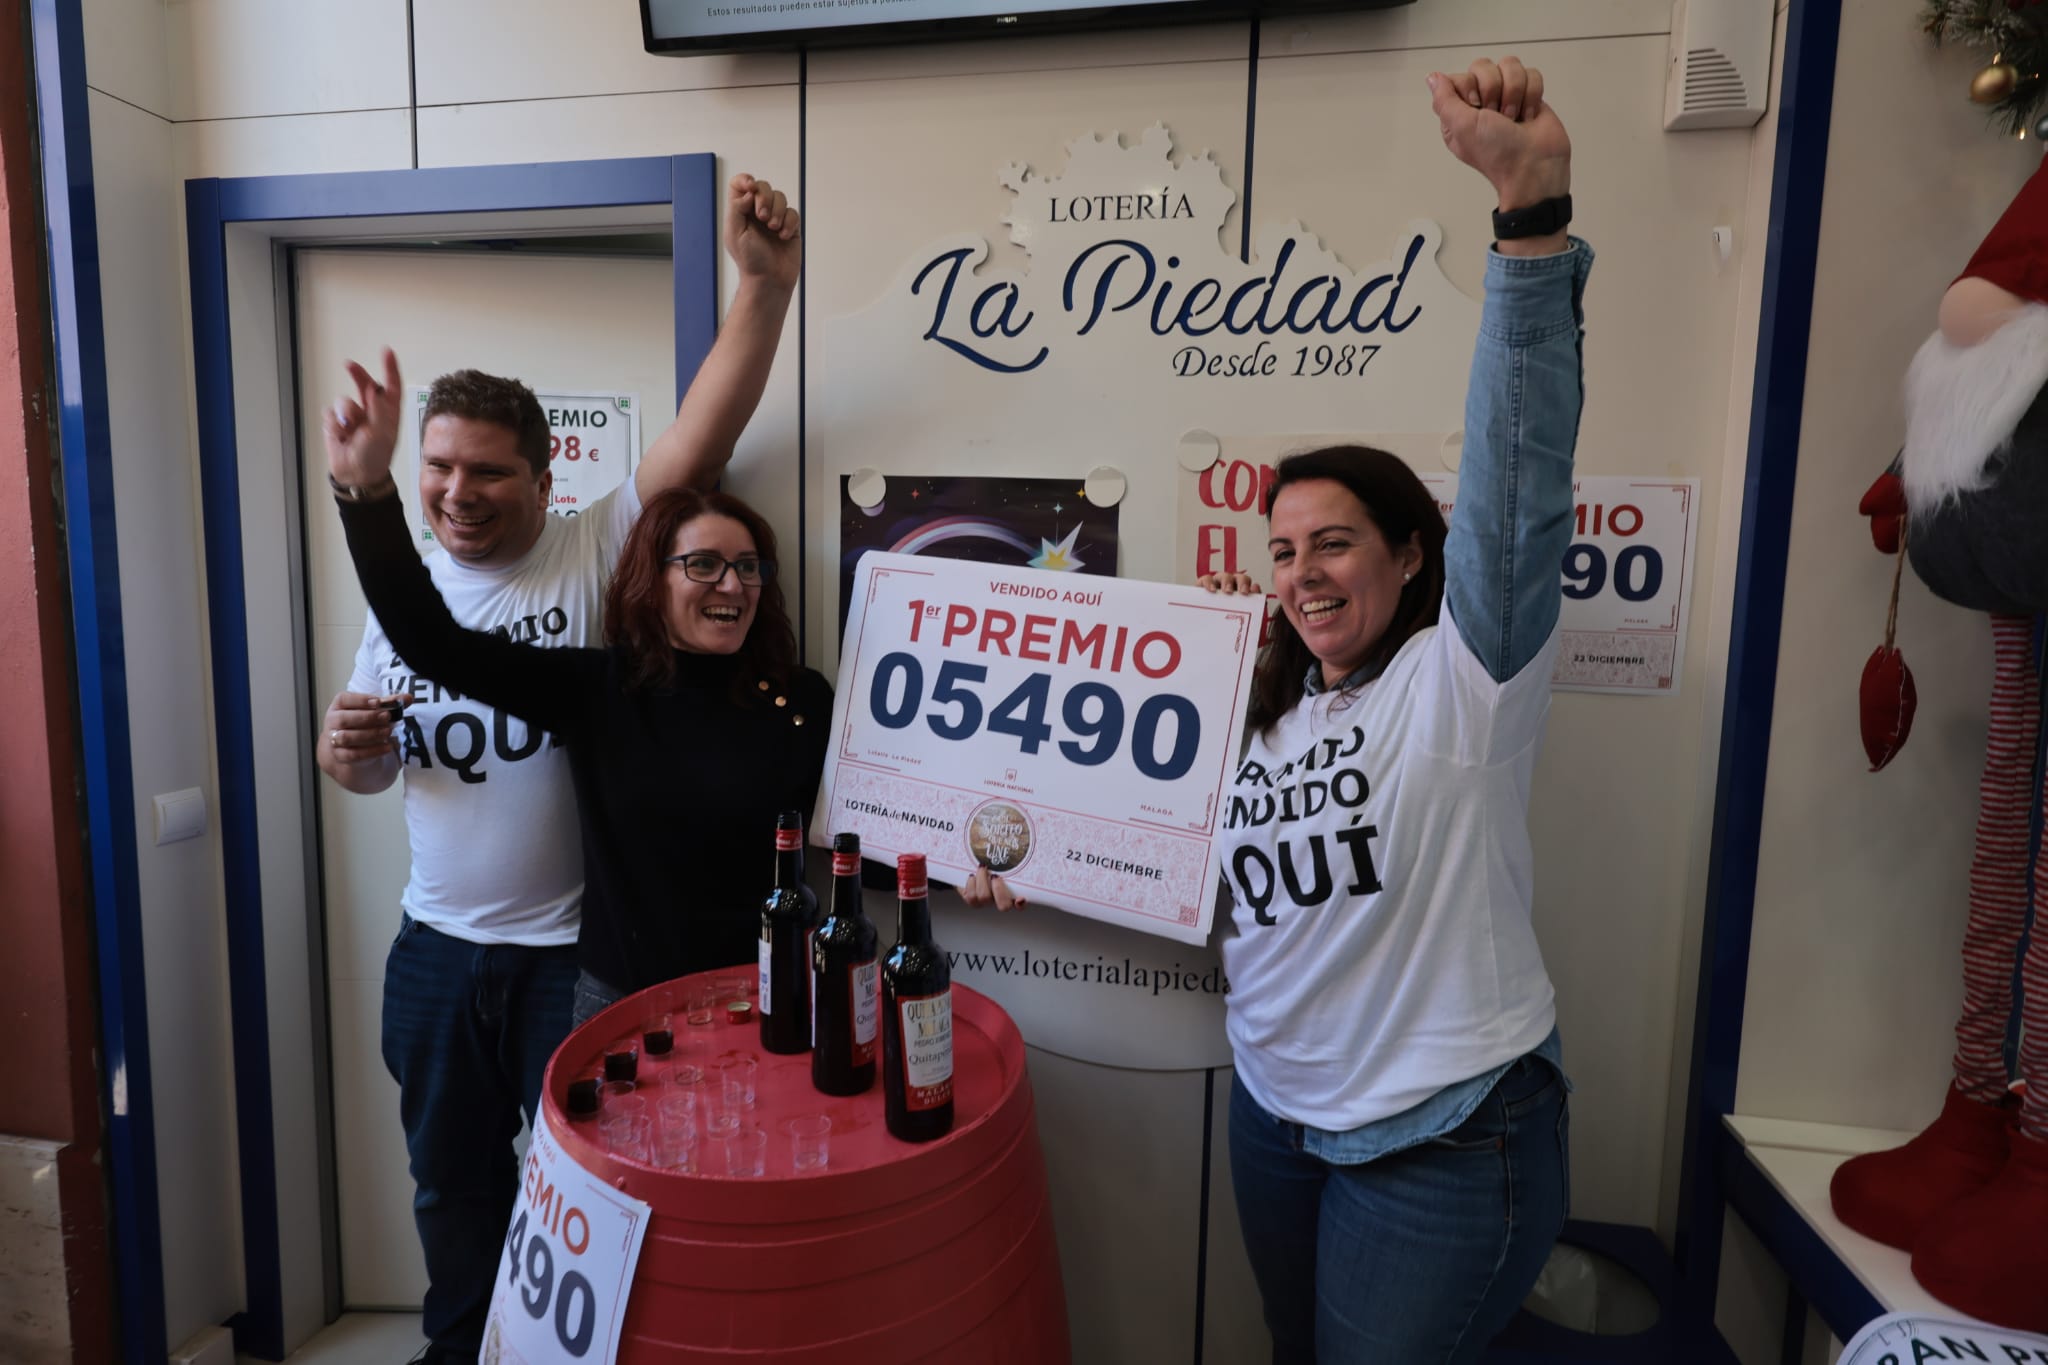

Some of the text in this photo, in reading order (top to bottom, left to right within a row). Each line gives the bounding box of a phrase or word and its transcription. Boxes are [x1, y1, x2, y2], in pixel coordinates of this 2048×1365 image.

[707, 7, 731, 17] Estos
[733, 4, 777, 15] resultados
[780, 2, 810, 13] pueden
[813, 0, 834, 8] estar
[1049, 193, 1195, 223] LOTERÍA
[911, 233, 1425, 374] La Piedad
[1172, 340, 1382, 379] Desde 1987
[549, 408, 607, 428] EMIO
[550, 435, 599, 462] 98 €
[555, 495, 577, 504] Loto
[1196, 524, 1248, 577] EL
[1561, 543, 1663, 602] 90
[990, 581, 1103, 606] VENDIDO AQUÍ
[908, 599, 1182, 679] 1er PREMIO
[1588, 655, 1645, 665] DICIEMBRE
[388, 673, 468, 705] VEN
[869, 651, 1201, 781] 05490
[403, 708, 566, 784] AQU
[901, 811, 954, 832] NAVIDAD
[1066, 849, 1163, 881] 22 DICIEMBRE
[1220, 814, 1383, 926] QUÍ
[525, 1152, 590, 1256] EMIO
[508, 1208, 596, 1358] 490
